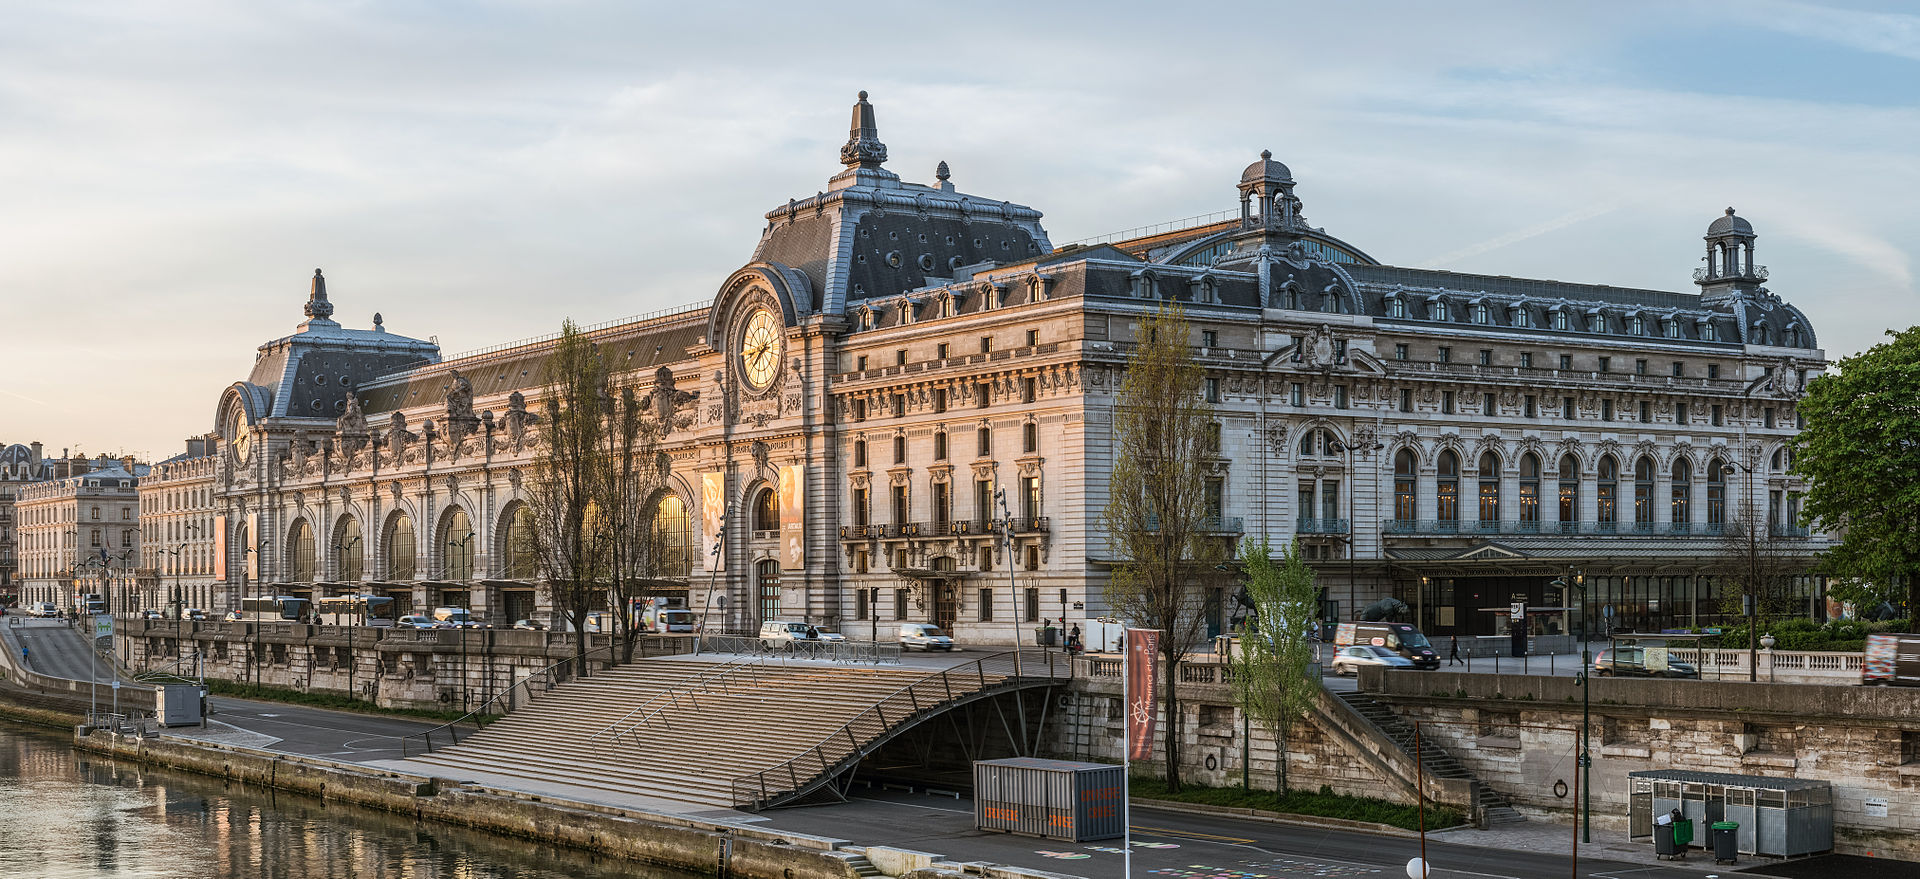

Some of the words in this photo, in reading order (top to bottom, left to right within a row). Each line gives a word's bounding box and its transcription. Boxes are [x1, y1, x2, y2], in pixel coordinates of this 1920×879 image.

[1143, 633, 1156, 655] Paris
[1146, 658, 1154, 672] de
[1145, 675, 1154, 710] Marina
[1081, 786, 1120, 802] CROISIERE
[1088, 804, 1116, 819] CRUISE
[1048, 814, 1073, 829] CRUISE
